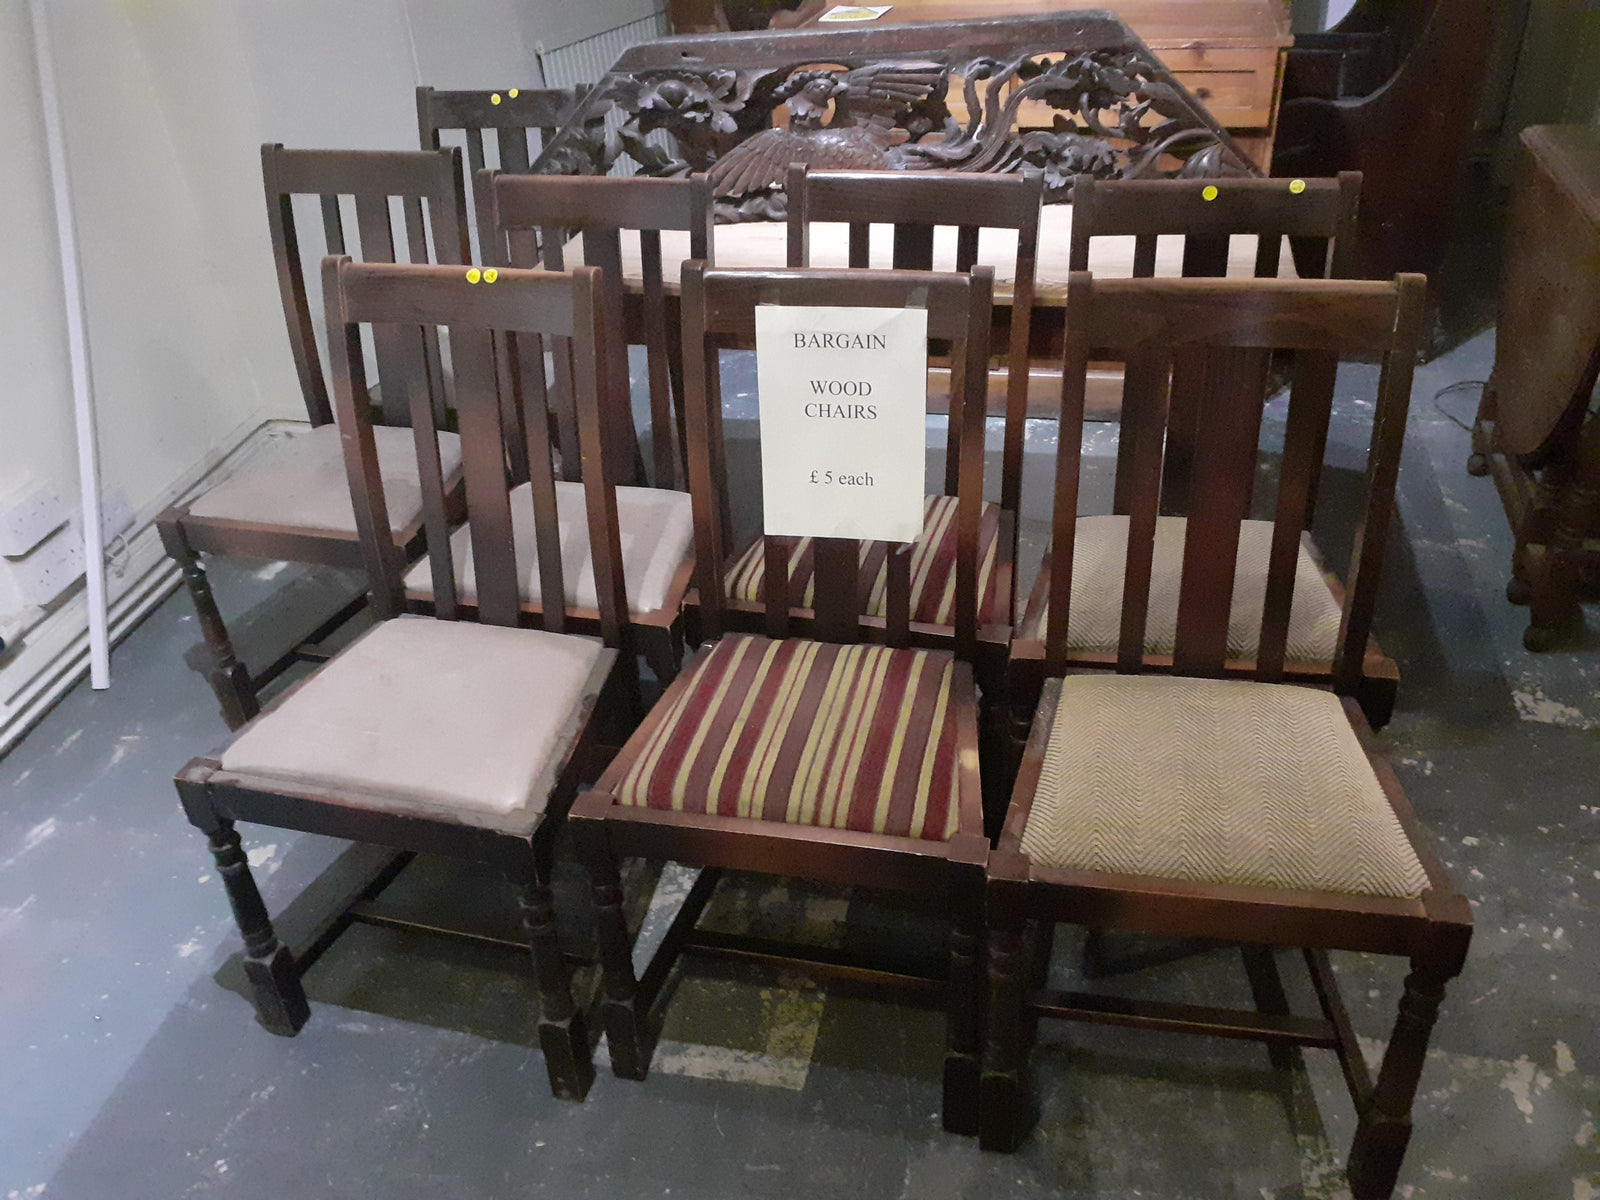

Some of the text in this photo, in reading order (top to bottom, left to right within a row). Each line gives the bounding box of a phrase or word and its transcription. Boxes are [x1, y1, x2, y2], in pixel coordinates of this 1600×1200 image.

[794, 333, 886, 350] BARGAIN
[810, 380, 872, 396] WOOD
[804, 403, 877, 419] CHAIRS
[838, 472, 874, 486] each
